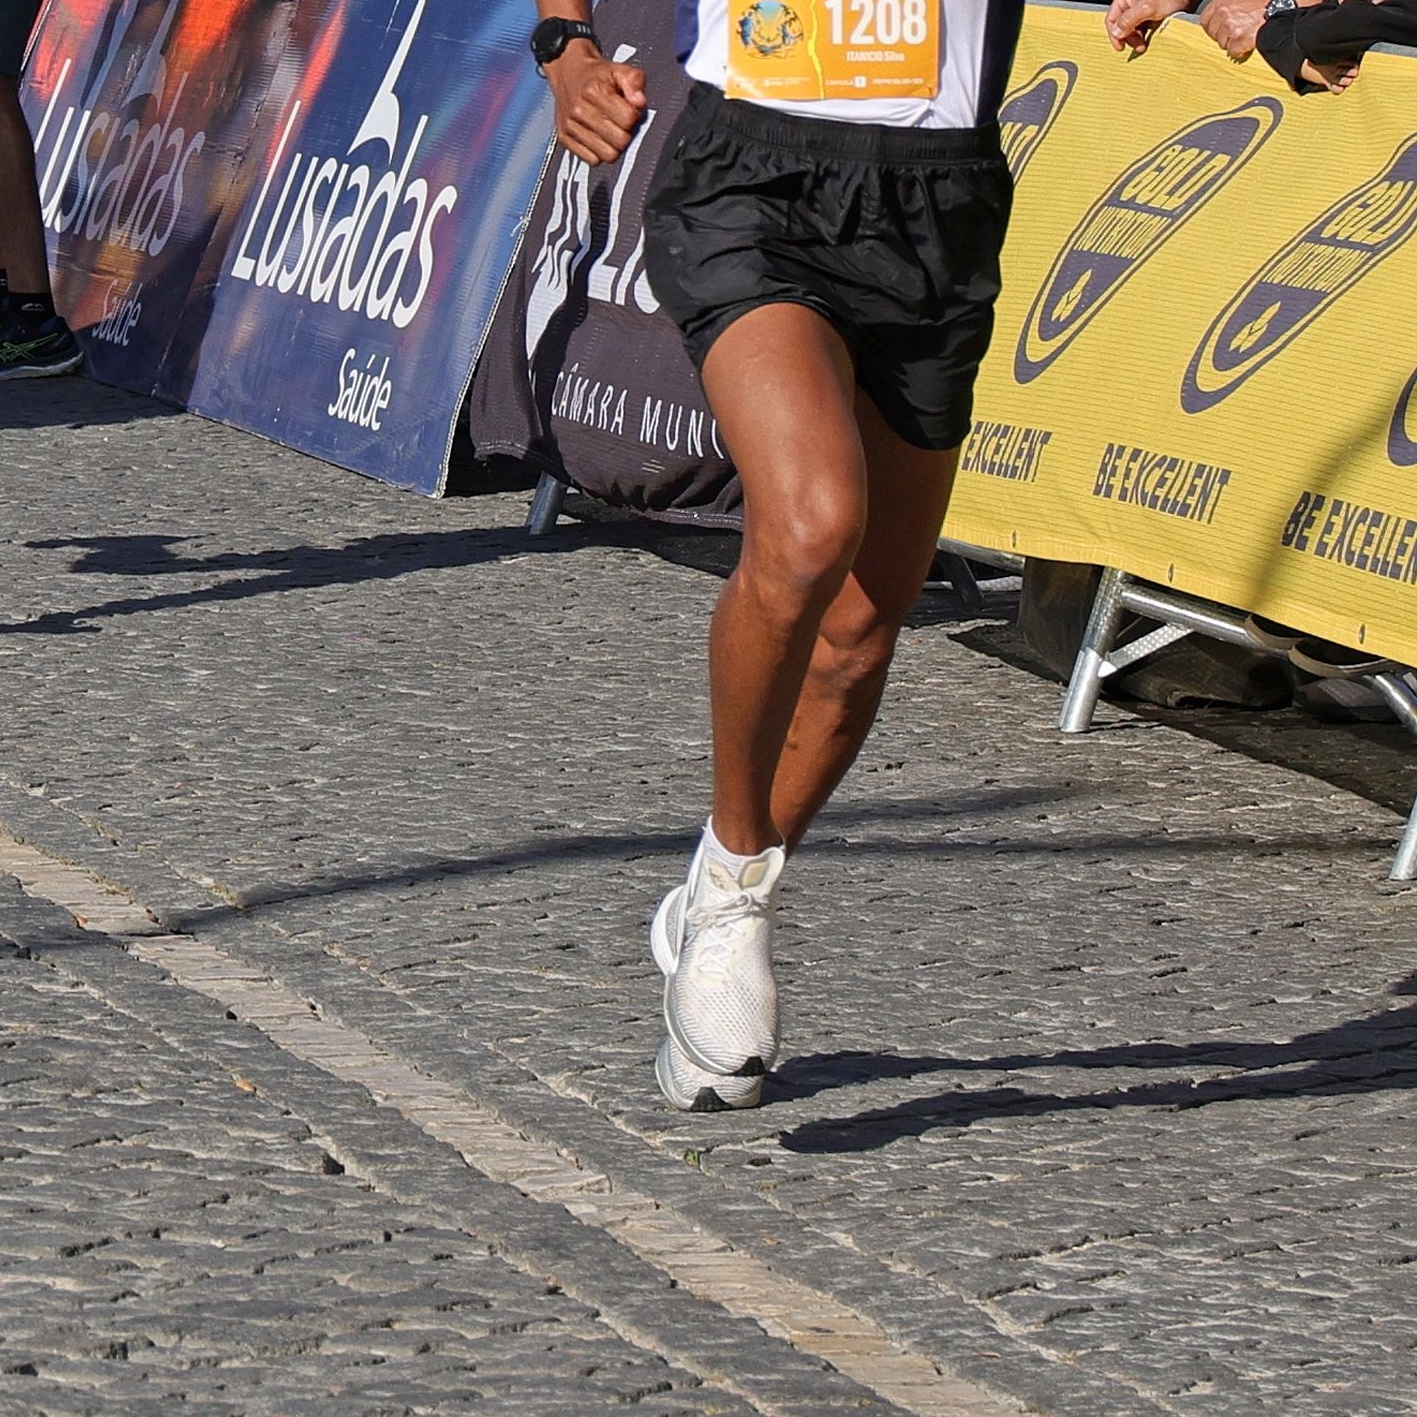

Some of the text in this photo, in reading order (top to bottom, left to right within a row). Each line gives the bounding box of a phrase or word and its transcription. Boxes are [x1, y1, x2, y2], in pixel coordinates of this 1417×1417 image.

[1119, 144, 1232, 211] GOLD
[328, 346, 392, 431] Saúde
[961, 421, 1053, 482] EXCELLENT
[1092, 442, 1232, 525] BE EXCELLENT
[1282, 490, 1327, 552] BE
